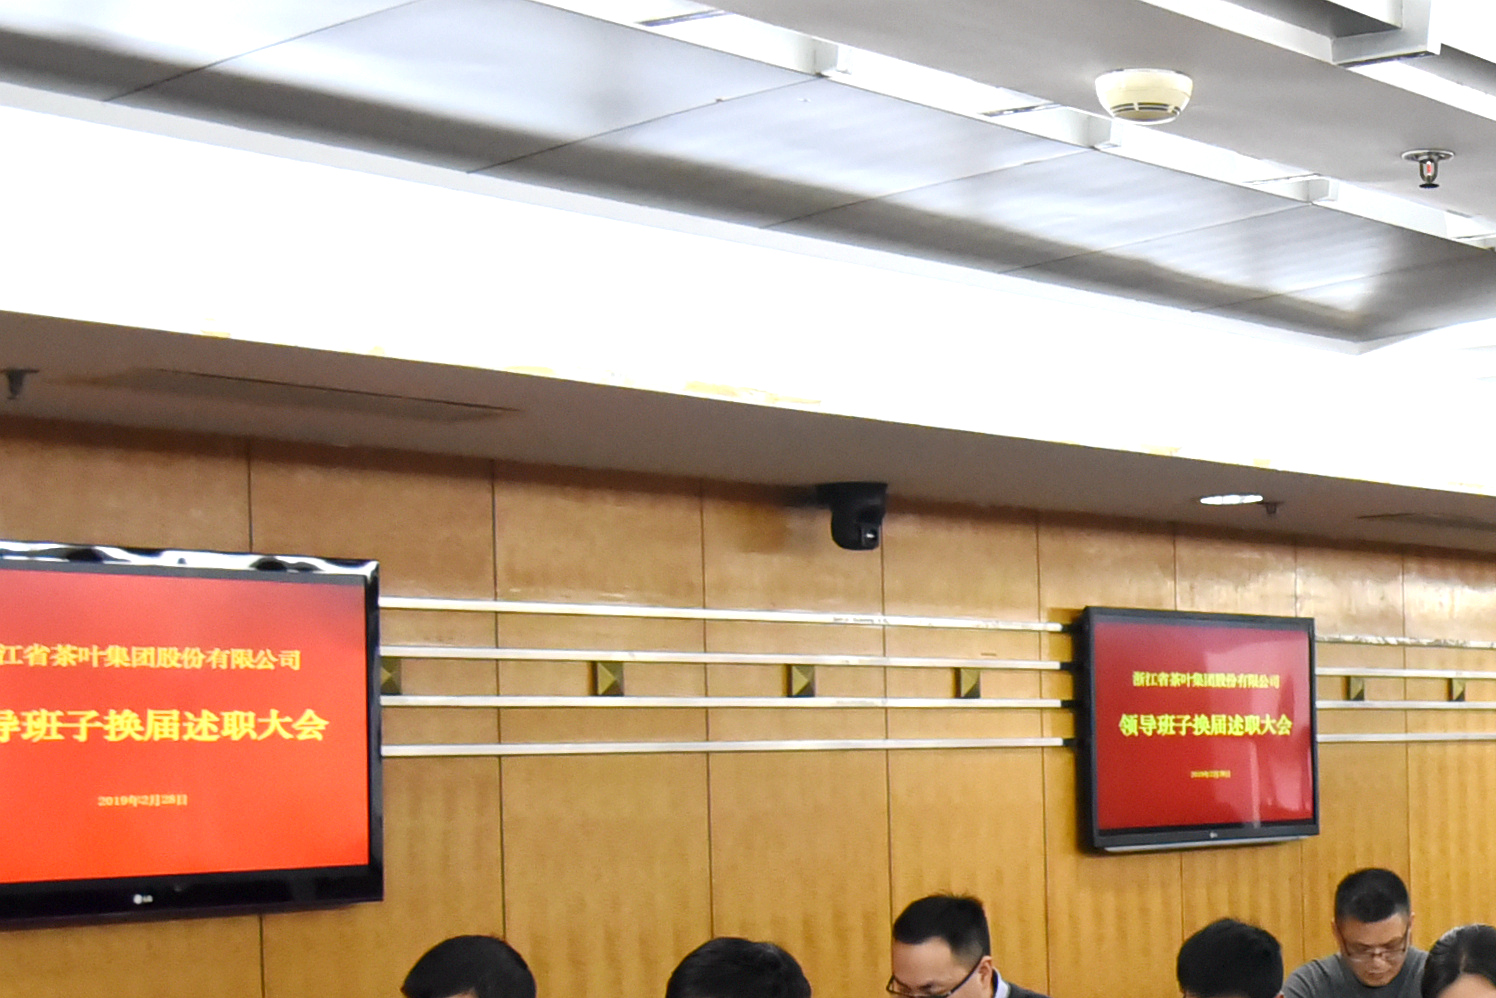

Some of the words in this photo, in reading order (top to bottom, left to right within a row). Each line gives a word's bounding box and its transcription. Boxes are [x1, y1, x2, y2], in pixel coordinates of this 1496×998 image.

[0, 643, 301, 671] 江省茶叶集团股份有限公司
[1118, 713, 1293, 737] 领导班子换届述职大会
